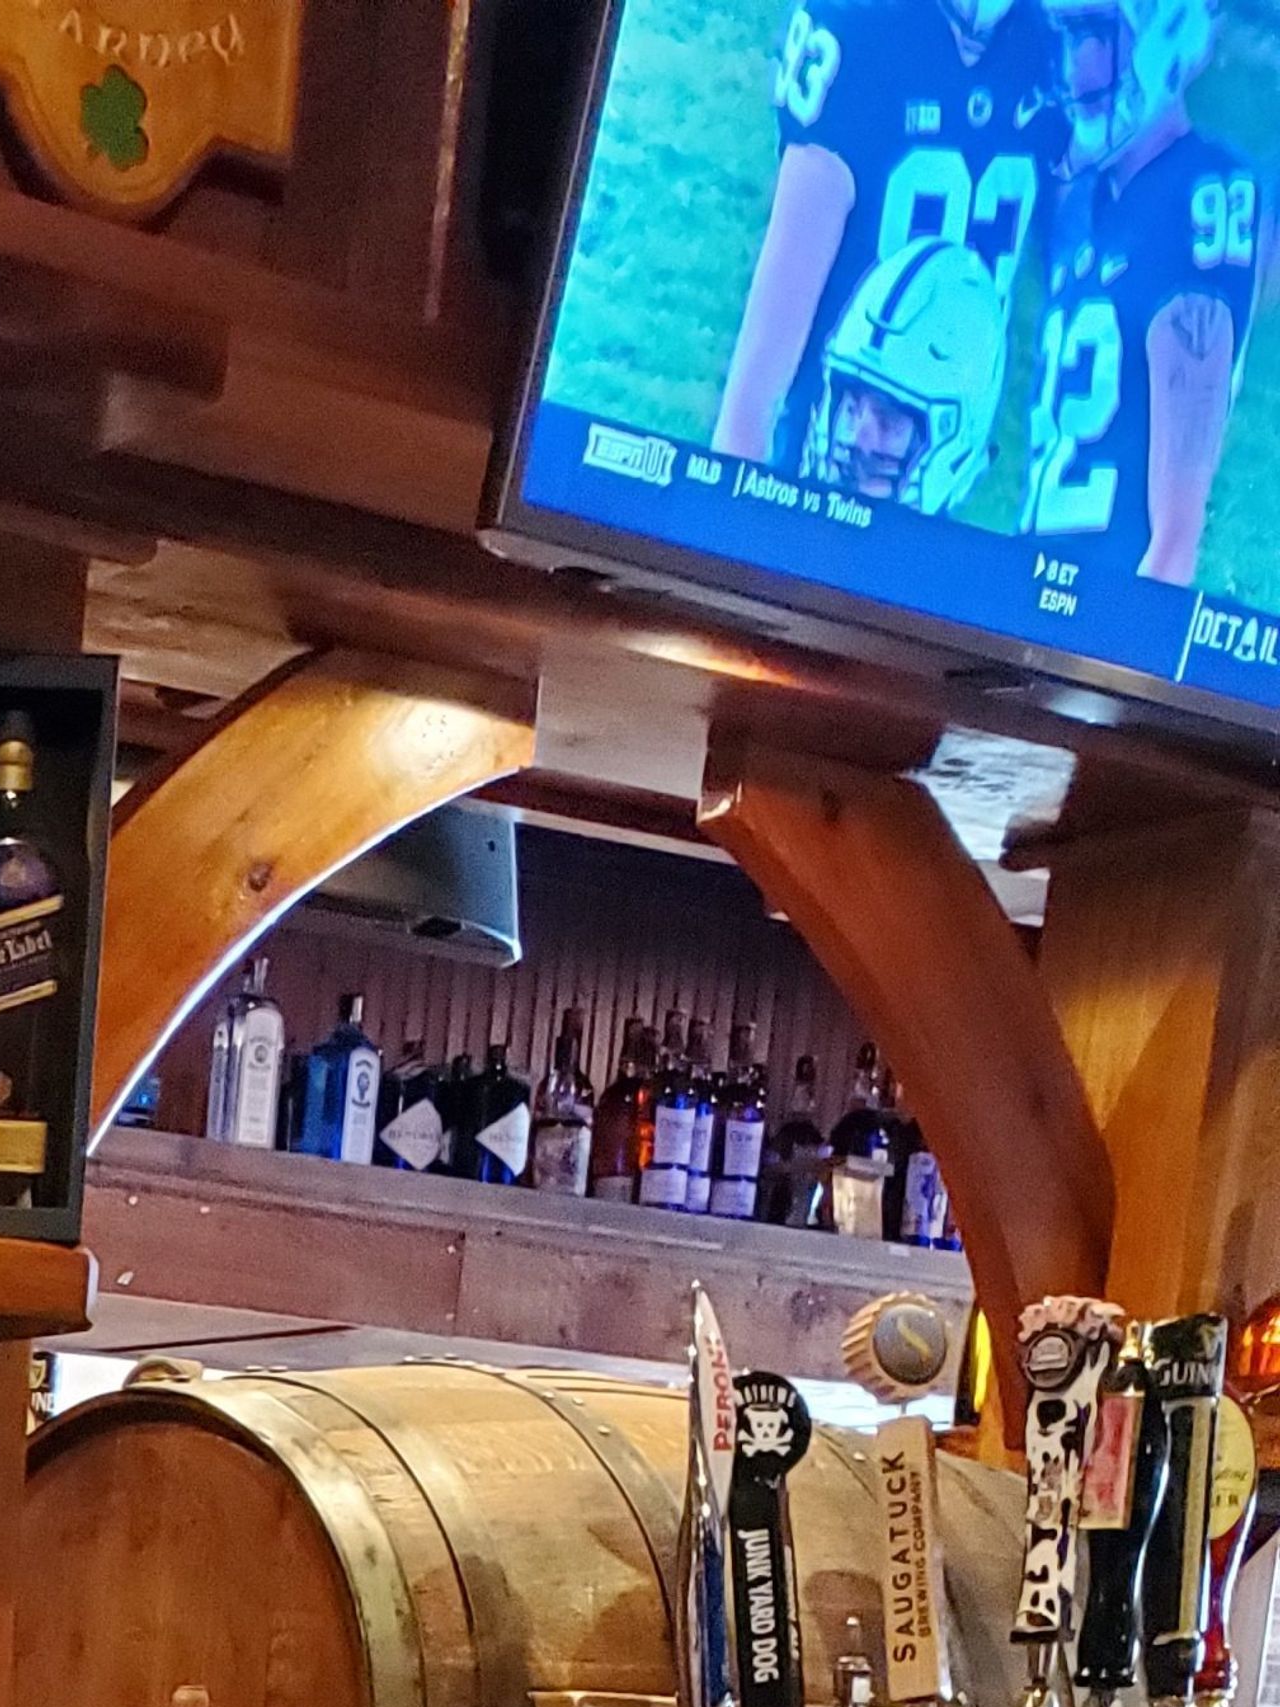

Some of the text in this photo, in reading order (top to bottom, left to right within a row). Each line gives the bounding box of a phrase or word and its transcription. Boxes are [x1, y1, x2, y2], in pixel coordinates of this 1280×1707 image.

[742, 474, 800, 508] Astros
[825, 490, 873, 529] Twins
[1038, 587, 1078, 618] ESPN
[1151, 1354, 1212, 1387] GUIN
[736, 1527, 781, 1684] JUNK YARD DOG
[881, 1450, 917, 1663] SAUGATUCK
[908, 1470, 933, 1639] BREWING COMPANY
